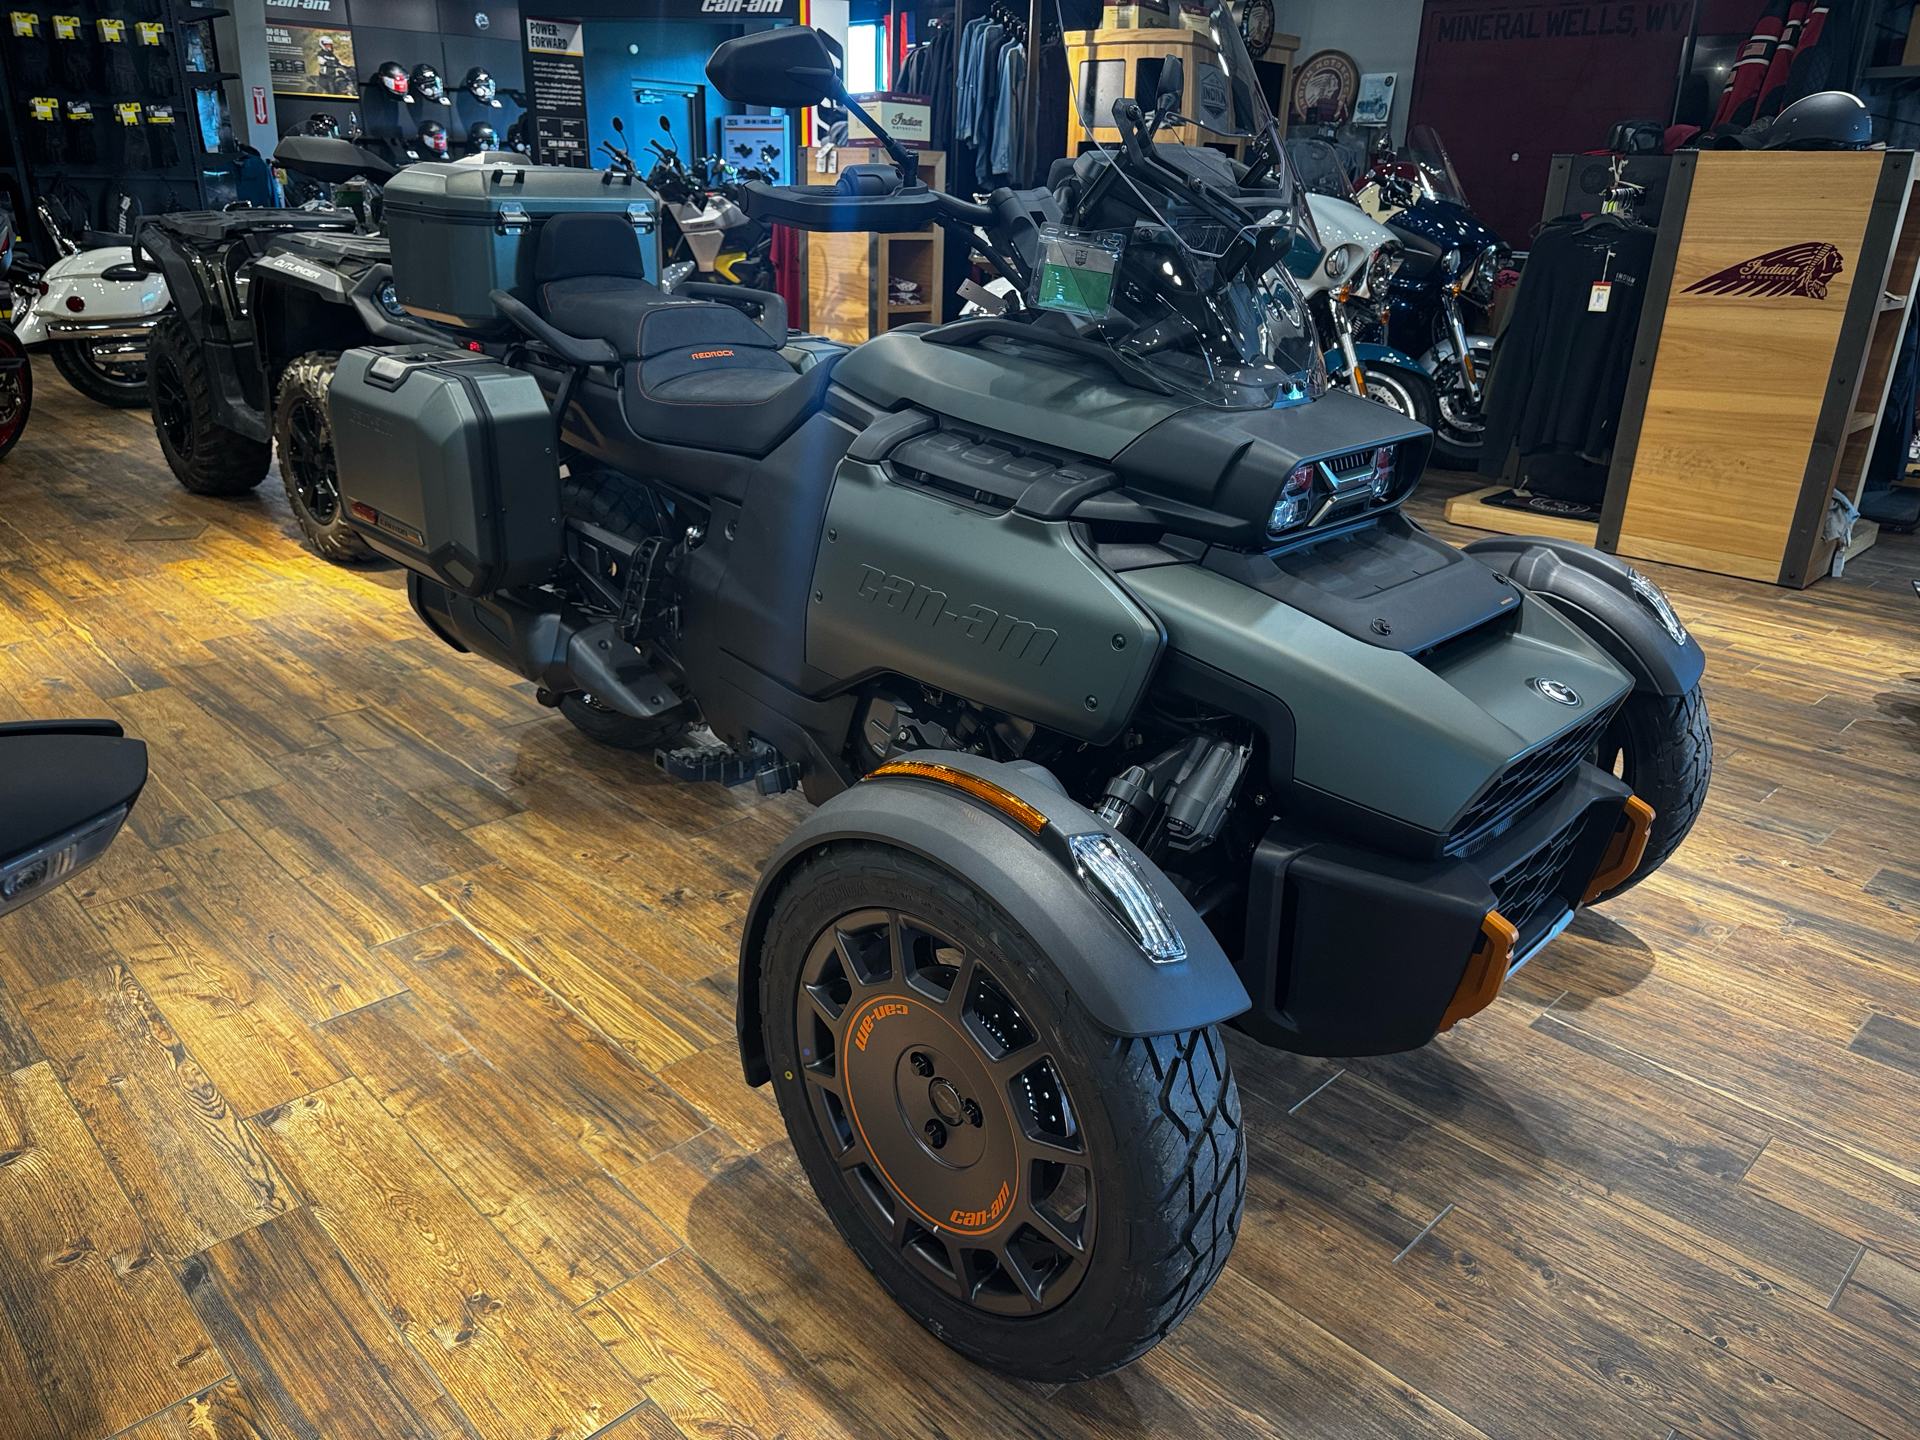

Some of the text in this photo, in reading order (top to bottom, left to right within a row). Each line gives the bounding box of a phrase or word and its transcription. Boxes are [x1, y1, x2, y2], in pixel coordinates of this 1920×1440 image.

[701, 0, 784, 13] can-am
[530, 22, 560, 36] POWER-
[1437, 11, 1542, 43] MINERAL
[1644, 1, 1691, 33] WV
[531, 35, 568, 50] FORWARD
[891, 112, 923, 128] Indian
[273, 259, 322, 280] OUTLANDER
[1739, 259, 1800, 276] Indian
[691, 350, 735, 360] REDROCK
[858, 563, 1060, 667] can-am
[854, 1003, 909, 1052] can-am
[949, 1180, 1010, 1227] can-am
